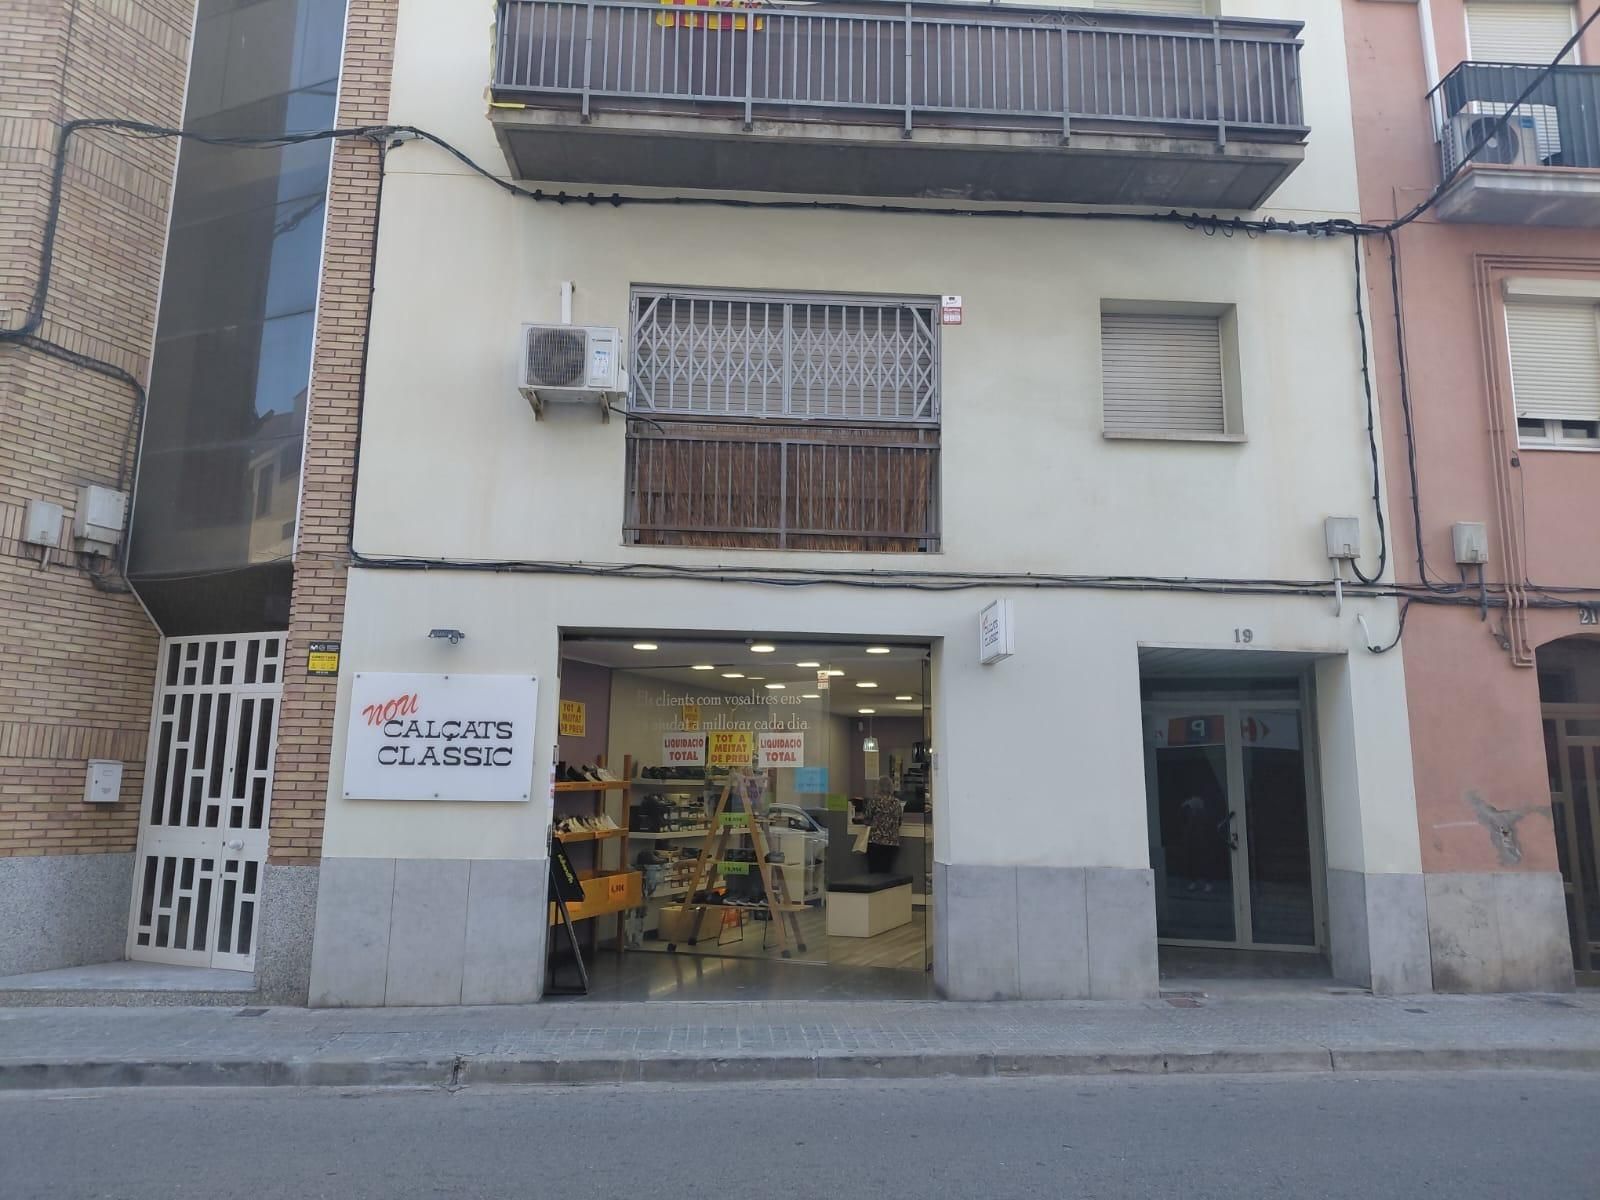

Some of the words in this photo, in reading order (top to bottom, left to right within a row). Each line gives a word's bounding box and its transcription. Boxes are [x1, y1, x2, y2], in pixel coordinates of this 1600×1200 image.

[1579, 608, 1598, 625] 21
[1234, 628, 1253, 643] 19
[656, 689, 694, 707] clients
[697, 695, 722, 706] com
[724, 688, 778, 705] vosaltres
[780, 695, 802, 705] ens
[703, 713, 751, 730] millorar
[754, 712, 785, 729] cada
[383, 720, 513, 741] CALÇATS
[664, 736, 704, 749] LIQUIDACIÓ
[716, 734, 733, 743] TOT
[738, 735, 745, 743] A
[760, 736, 802, 749] LIQUIDACIÓ
[714, 744, 748, 753] MEITAT
[377, 746, 513, 767] CLASSIC
[669, 751, 699, 761] TOTAL
[711, 754, 721, 763] DE
[726, 754, 750, 763] PREU
[766, 752, 797, 762] TOTAL
